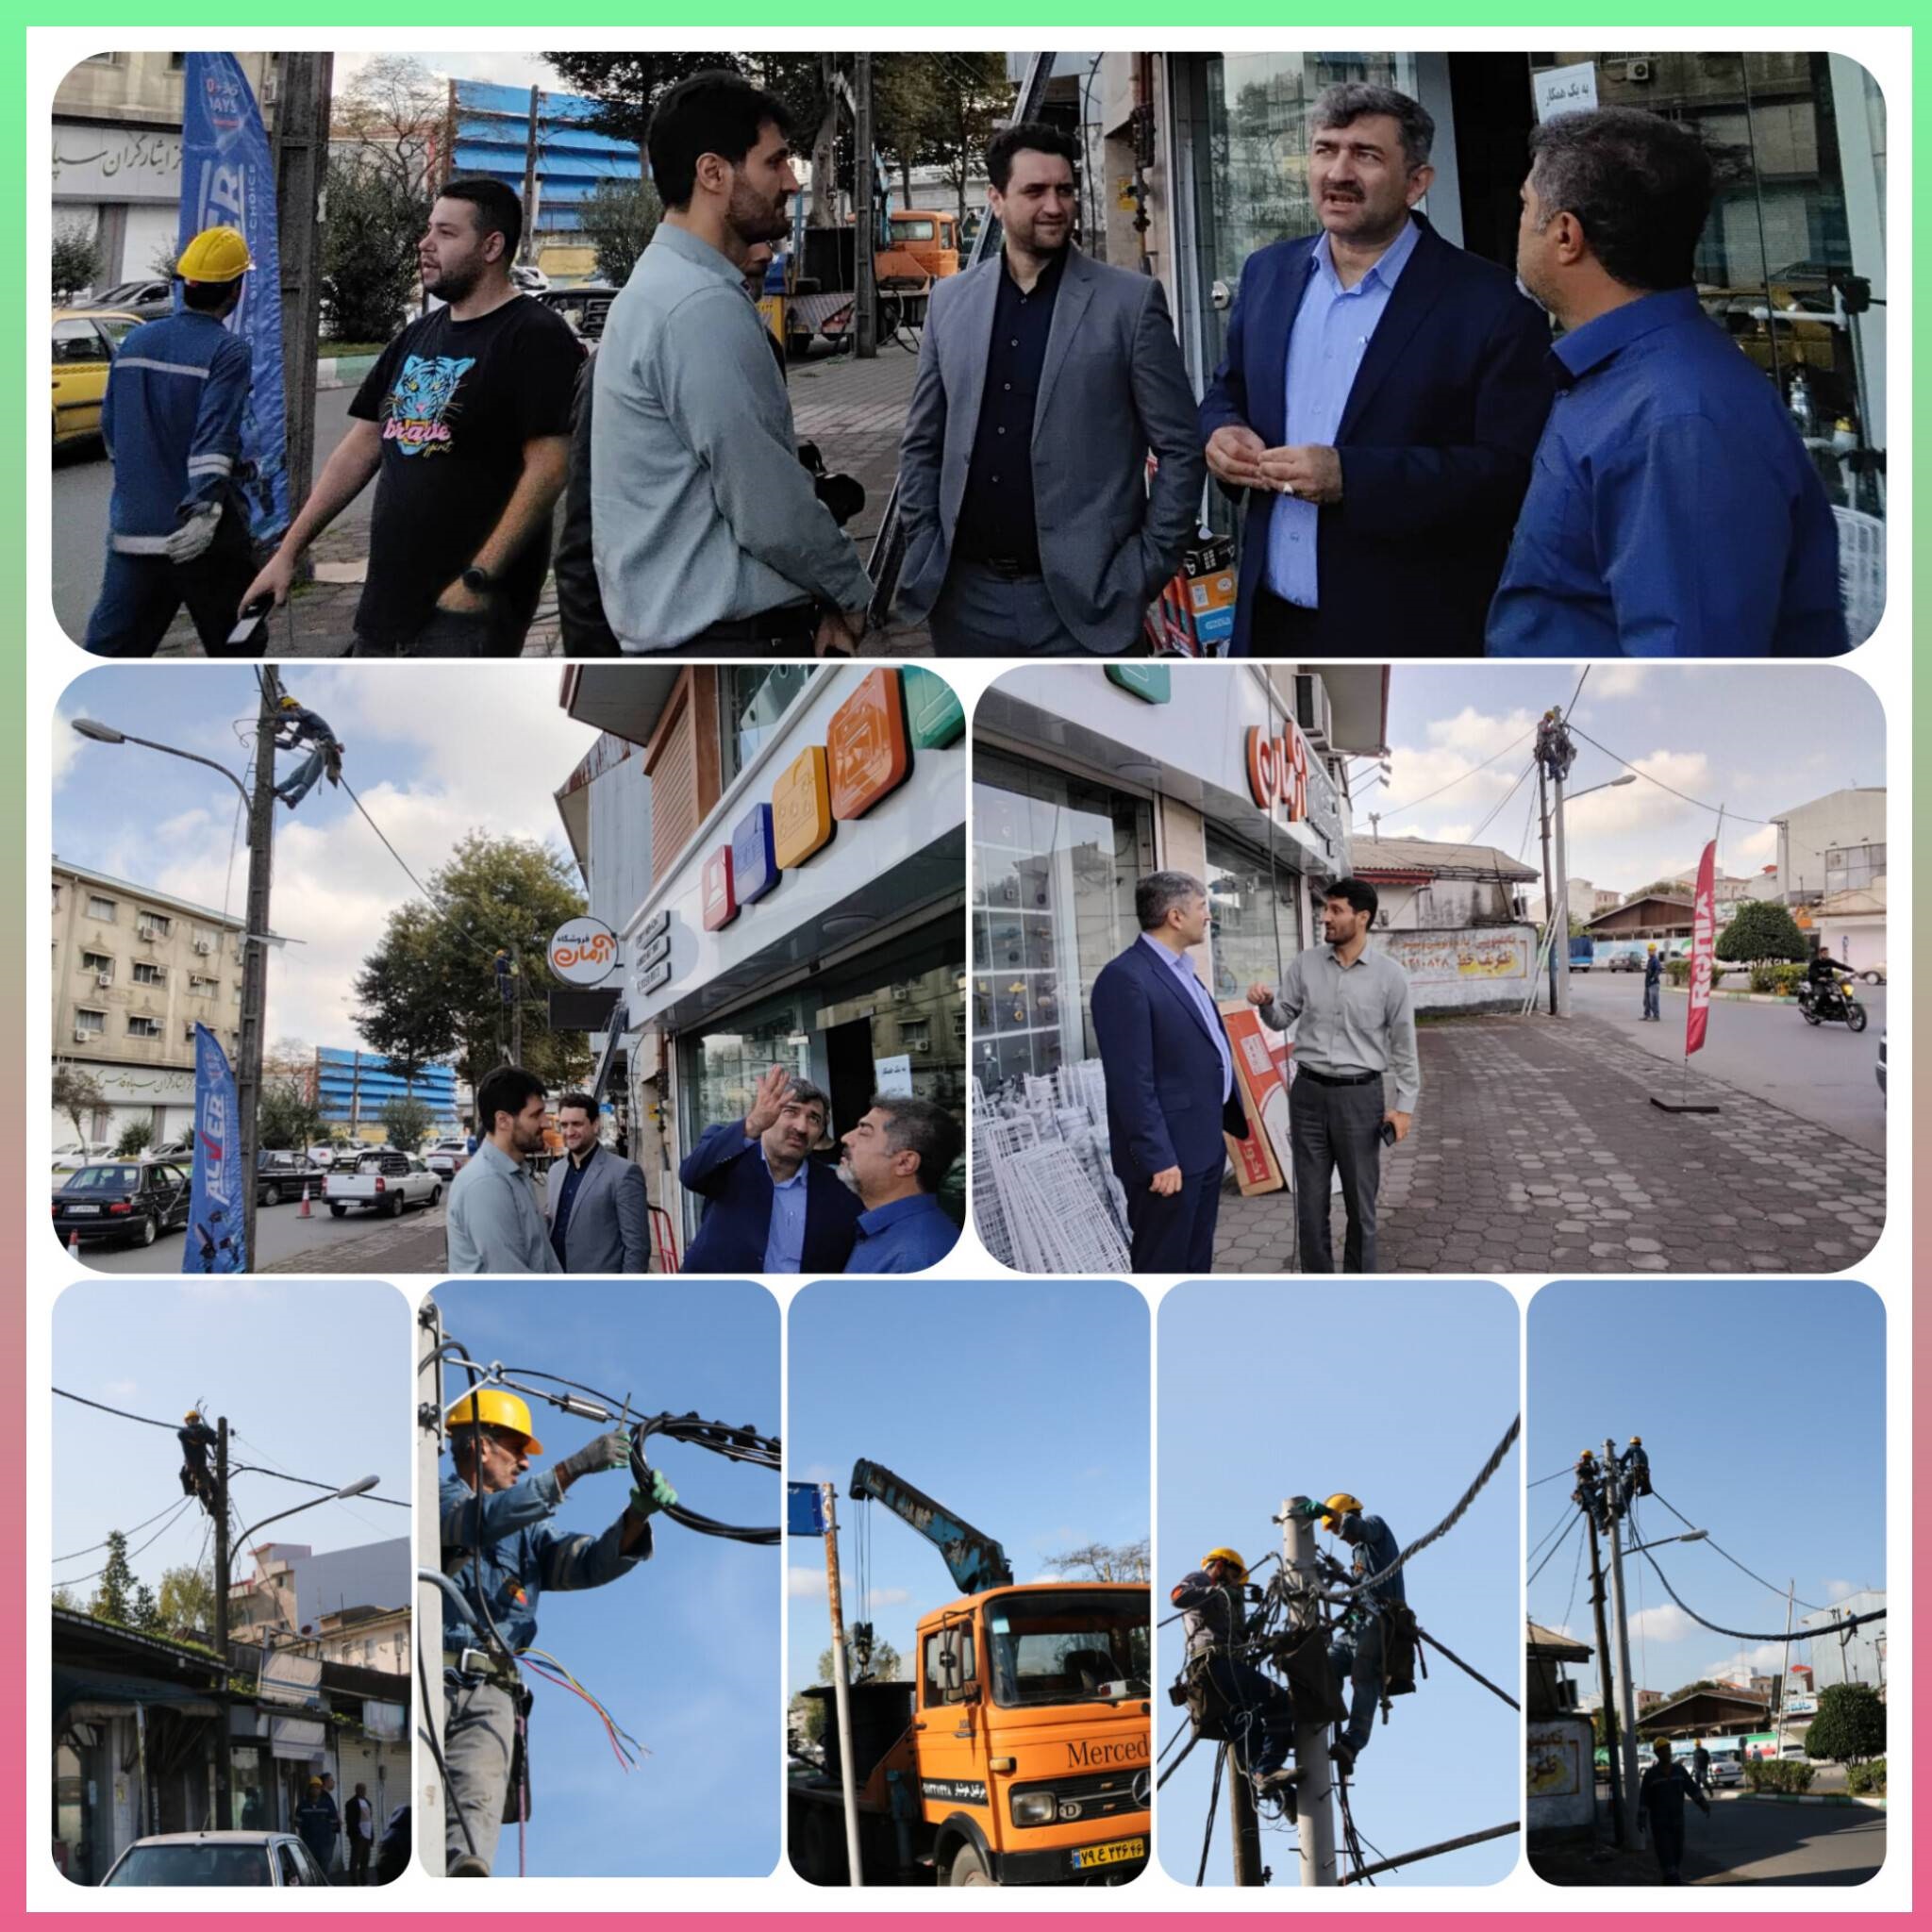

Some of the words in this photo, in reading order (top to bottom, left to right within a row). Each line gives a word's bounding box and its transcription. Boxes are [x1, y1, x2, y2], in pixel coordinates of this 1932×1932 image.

[52, 140, 108, 180] سپا
[247, 163, 258, 229] CHOICE
[383, 417, 451, 442] brave
[554, 933, 616, 968] آرمان
[557, 933, 591, 945] فروشگاه
[1242, 1138, 1266, 1180] اخوا
[1066, 1733, 1149, 1769] Merced
[1065, 1804, 1076, 1817] D
